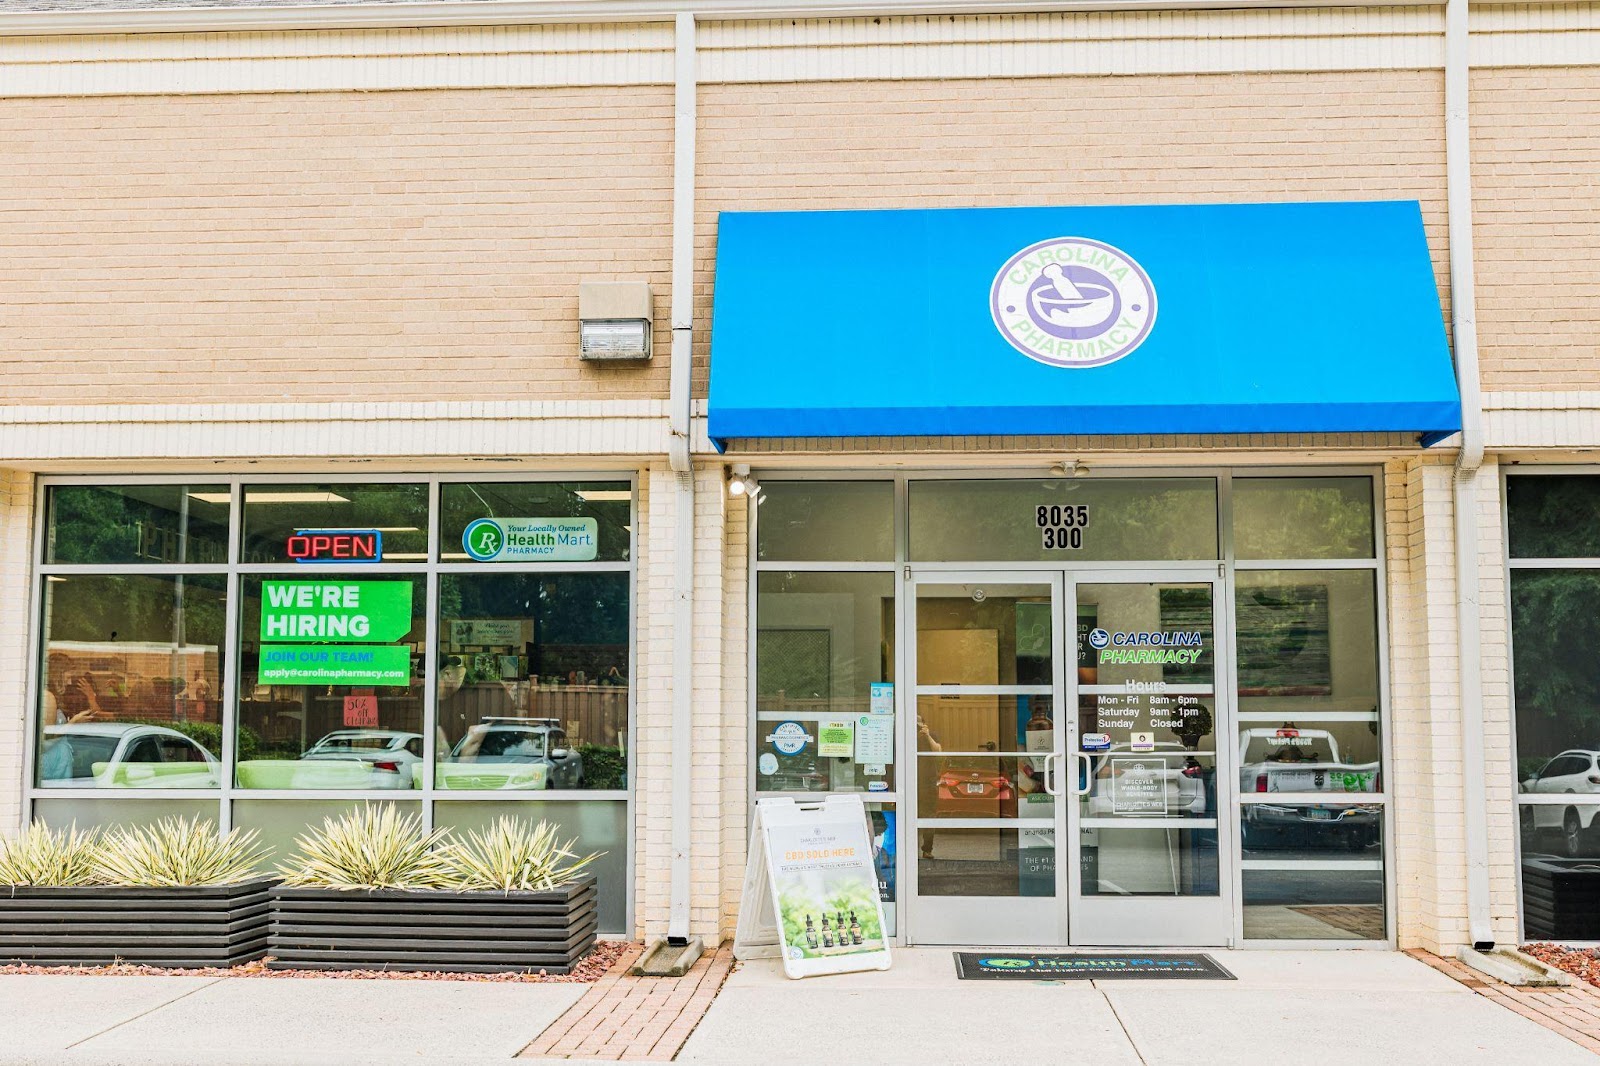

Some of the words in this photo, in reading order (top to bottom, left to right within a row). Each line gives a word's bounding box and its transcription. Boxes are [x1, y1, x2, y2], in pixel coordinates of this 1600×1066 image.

[1008, 247, 1129, 285] CAROLINA
[1010, 316, 1138, 358] PHARMACY
[1037, 505, 1088, 527] 8035
[528, 524, 557, 533] Locally
[507, 533, 555, 546] Health
[1044, 527, 1081, 549] 300
[287, 536, 374, 557] OPEN
[267, 585, 360, 608] WE'RE
[266, 614, 370, 638] HIRING
[1112, 631, 1203, 646] CAROLINA
[265, 652, 296, 662] JOIN
[300, 652, 328, 663] OUR
[333, 652, 374, 663] TEAM!
[1100, 648, 1203, 664] PHARMACY
[264, 668, 404, 679] apply@carolinapharmacy.com
[1125, 679, 1168, 692] Hours
[1098, 696, 1118, 704] Mon
[1126, 696, 1139, 704] Fri
[1150, 696, 1170, 704] 8am
[1178, 696, 1198, 706] 6pm
[1098, 708, 1140, 718] Saturday
[1150, 708, 1170, 716] 9am
[1178, 708, 1199, 718] 1pm
[1098, 719, 1134, 730] Sunday
[1150, 718, 1184, 728] Closed
[785, 850, 804, 860] CBD
[806, 850, 830, 860] SOLD
[832, 848, 855, 857] HERE
